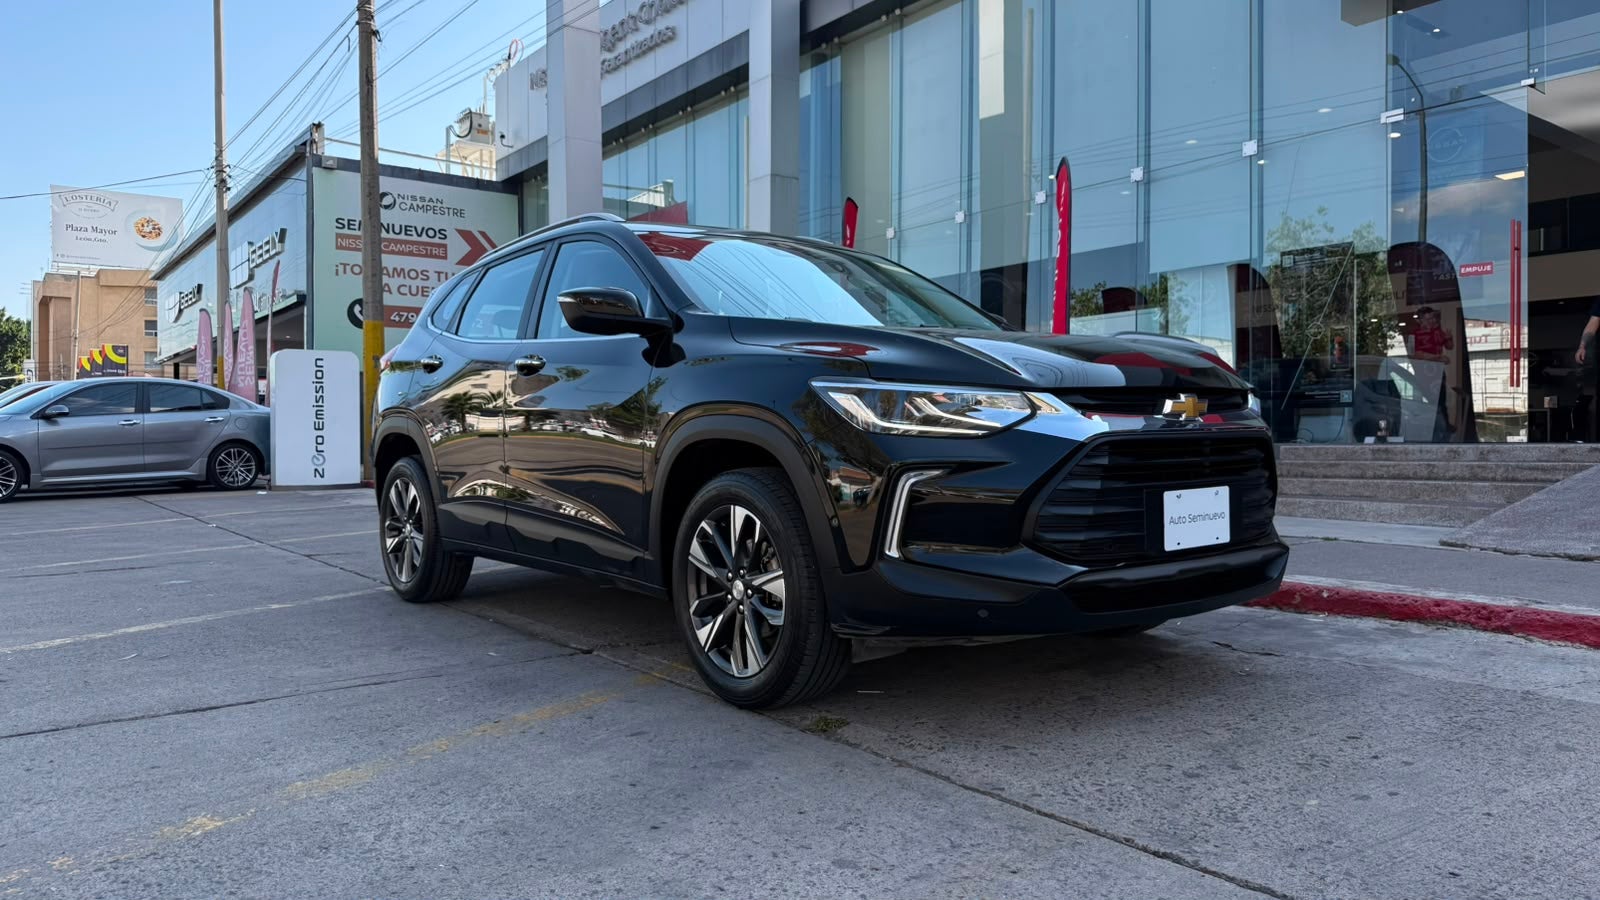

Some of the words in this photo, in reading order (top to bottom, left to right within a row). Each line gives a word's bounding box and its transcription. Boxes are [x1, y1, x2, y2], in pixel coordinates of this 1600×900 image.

[397, 193, 444, 205] NISSAN
[399, 202, 466, 219] CAMPESTRE
[65, 223, 89, 233] Plaza
[91, 226, 118, 237] Mayor
[250, 228, 287, 269] GEELY
[382, 242, 446, 257] CAMPESTRE
[1460, 264, 1492, 275] EMPUJE
[180, 283, 203, 310] GEELY
[311, 357, 325, 431] Emission
[1169, 515, 1187, 525] Auto
[1188, 511, 1226, 524] Seminuevo
